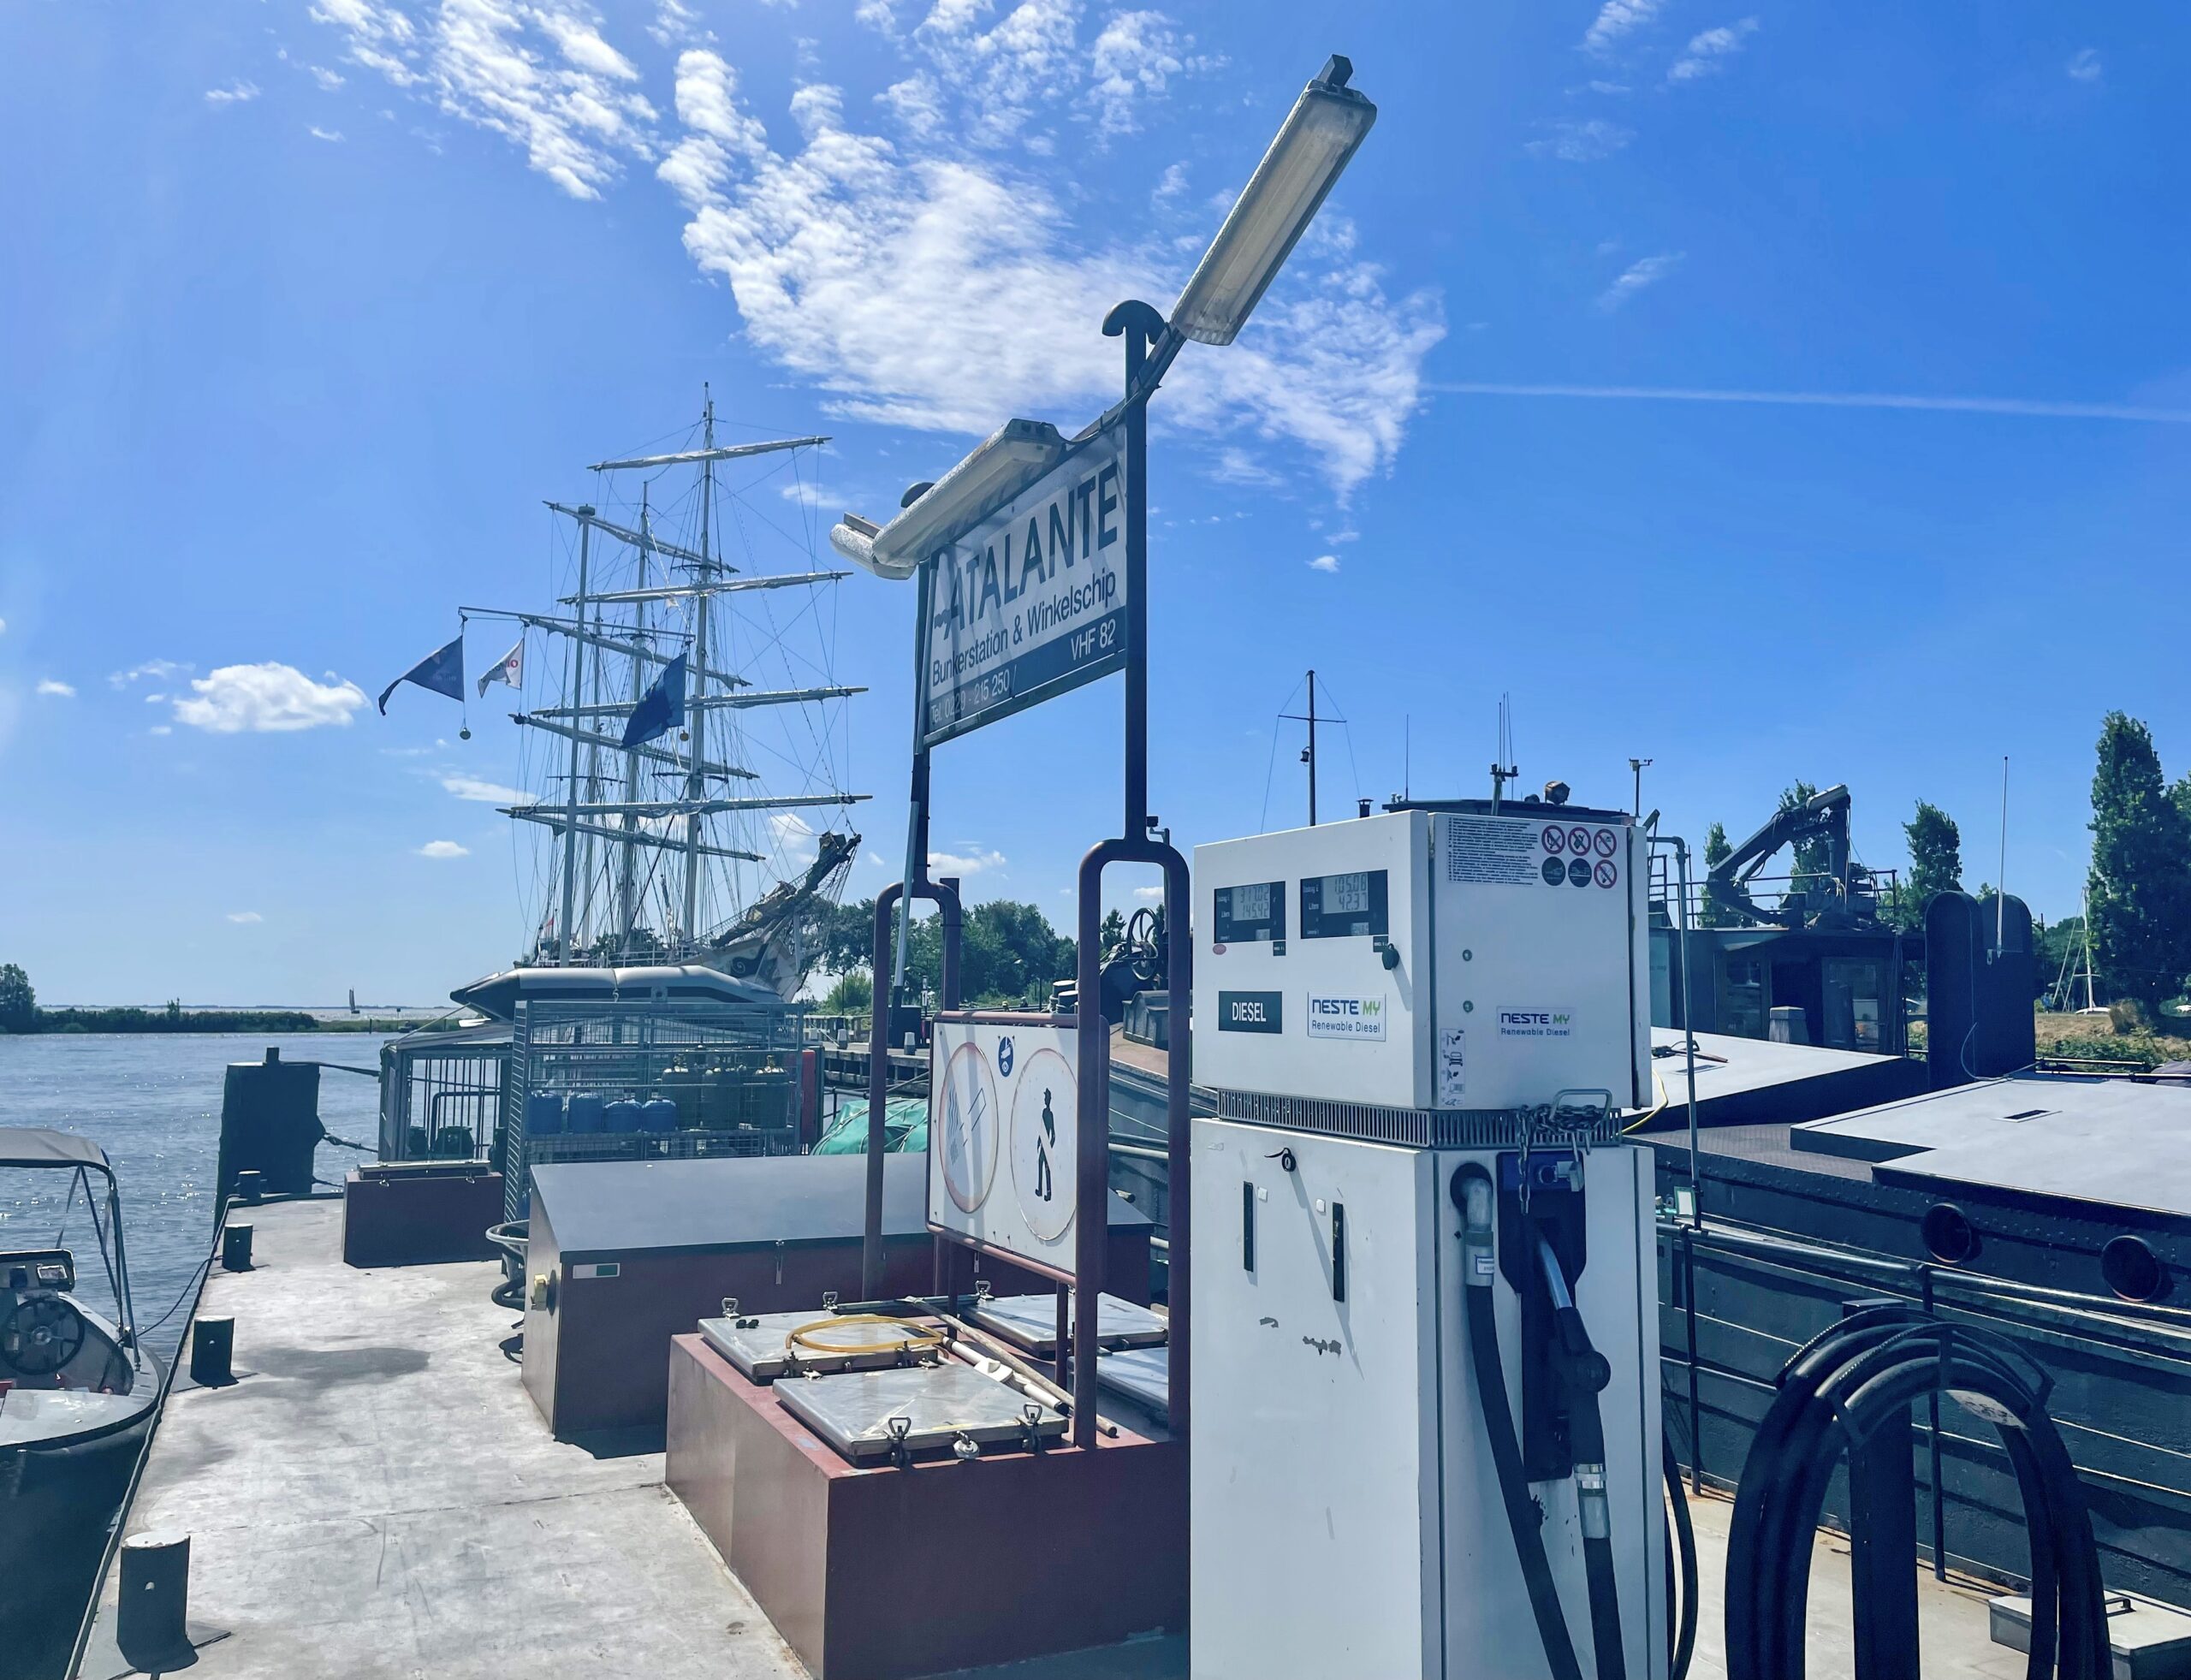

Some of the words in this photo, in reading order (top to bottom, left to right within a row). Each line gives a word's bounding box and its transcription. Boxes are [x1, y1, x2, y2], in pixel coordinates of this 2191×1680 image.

[935, 462, 1118, 640] ATALANTE
[932, 627, 1008, 687] Bunkerstation
[1012, 614, 1023, 644] &
[1027, 568, 1116, 637] Winkelschip
[1071, 626, 1096, 661] VHF
[1100, 619, 1116, 649] 82
[974, 679, 989, 705] 215
[992, 668, 1010, 697] 250
[1232, 1001, 1267, 1023] DIESEL
[1312, 1000, 1359, 1015] NESTE
[1363, 1000, 1381, 1016] MY
[1501, 1012, 1549, 1024] NESTE
[1553, 1014, 1571, 1024] MY
[1312, 1019, 1353, 1032] Renewable
[1356, 1021, 1381, 1034] Diesel
[1501, 1028, 1543, 1036] Renewable
